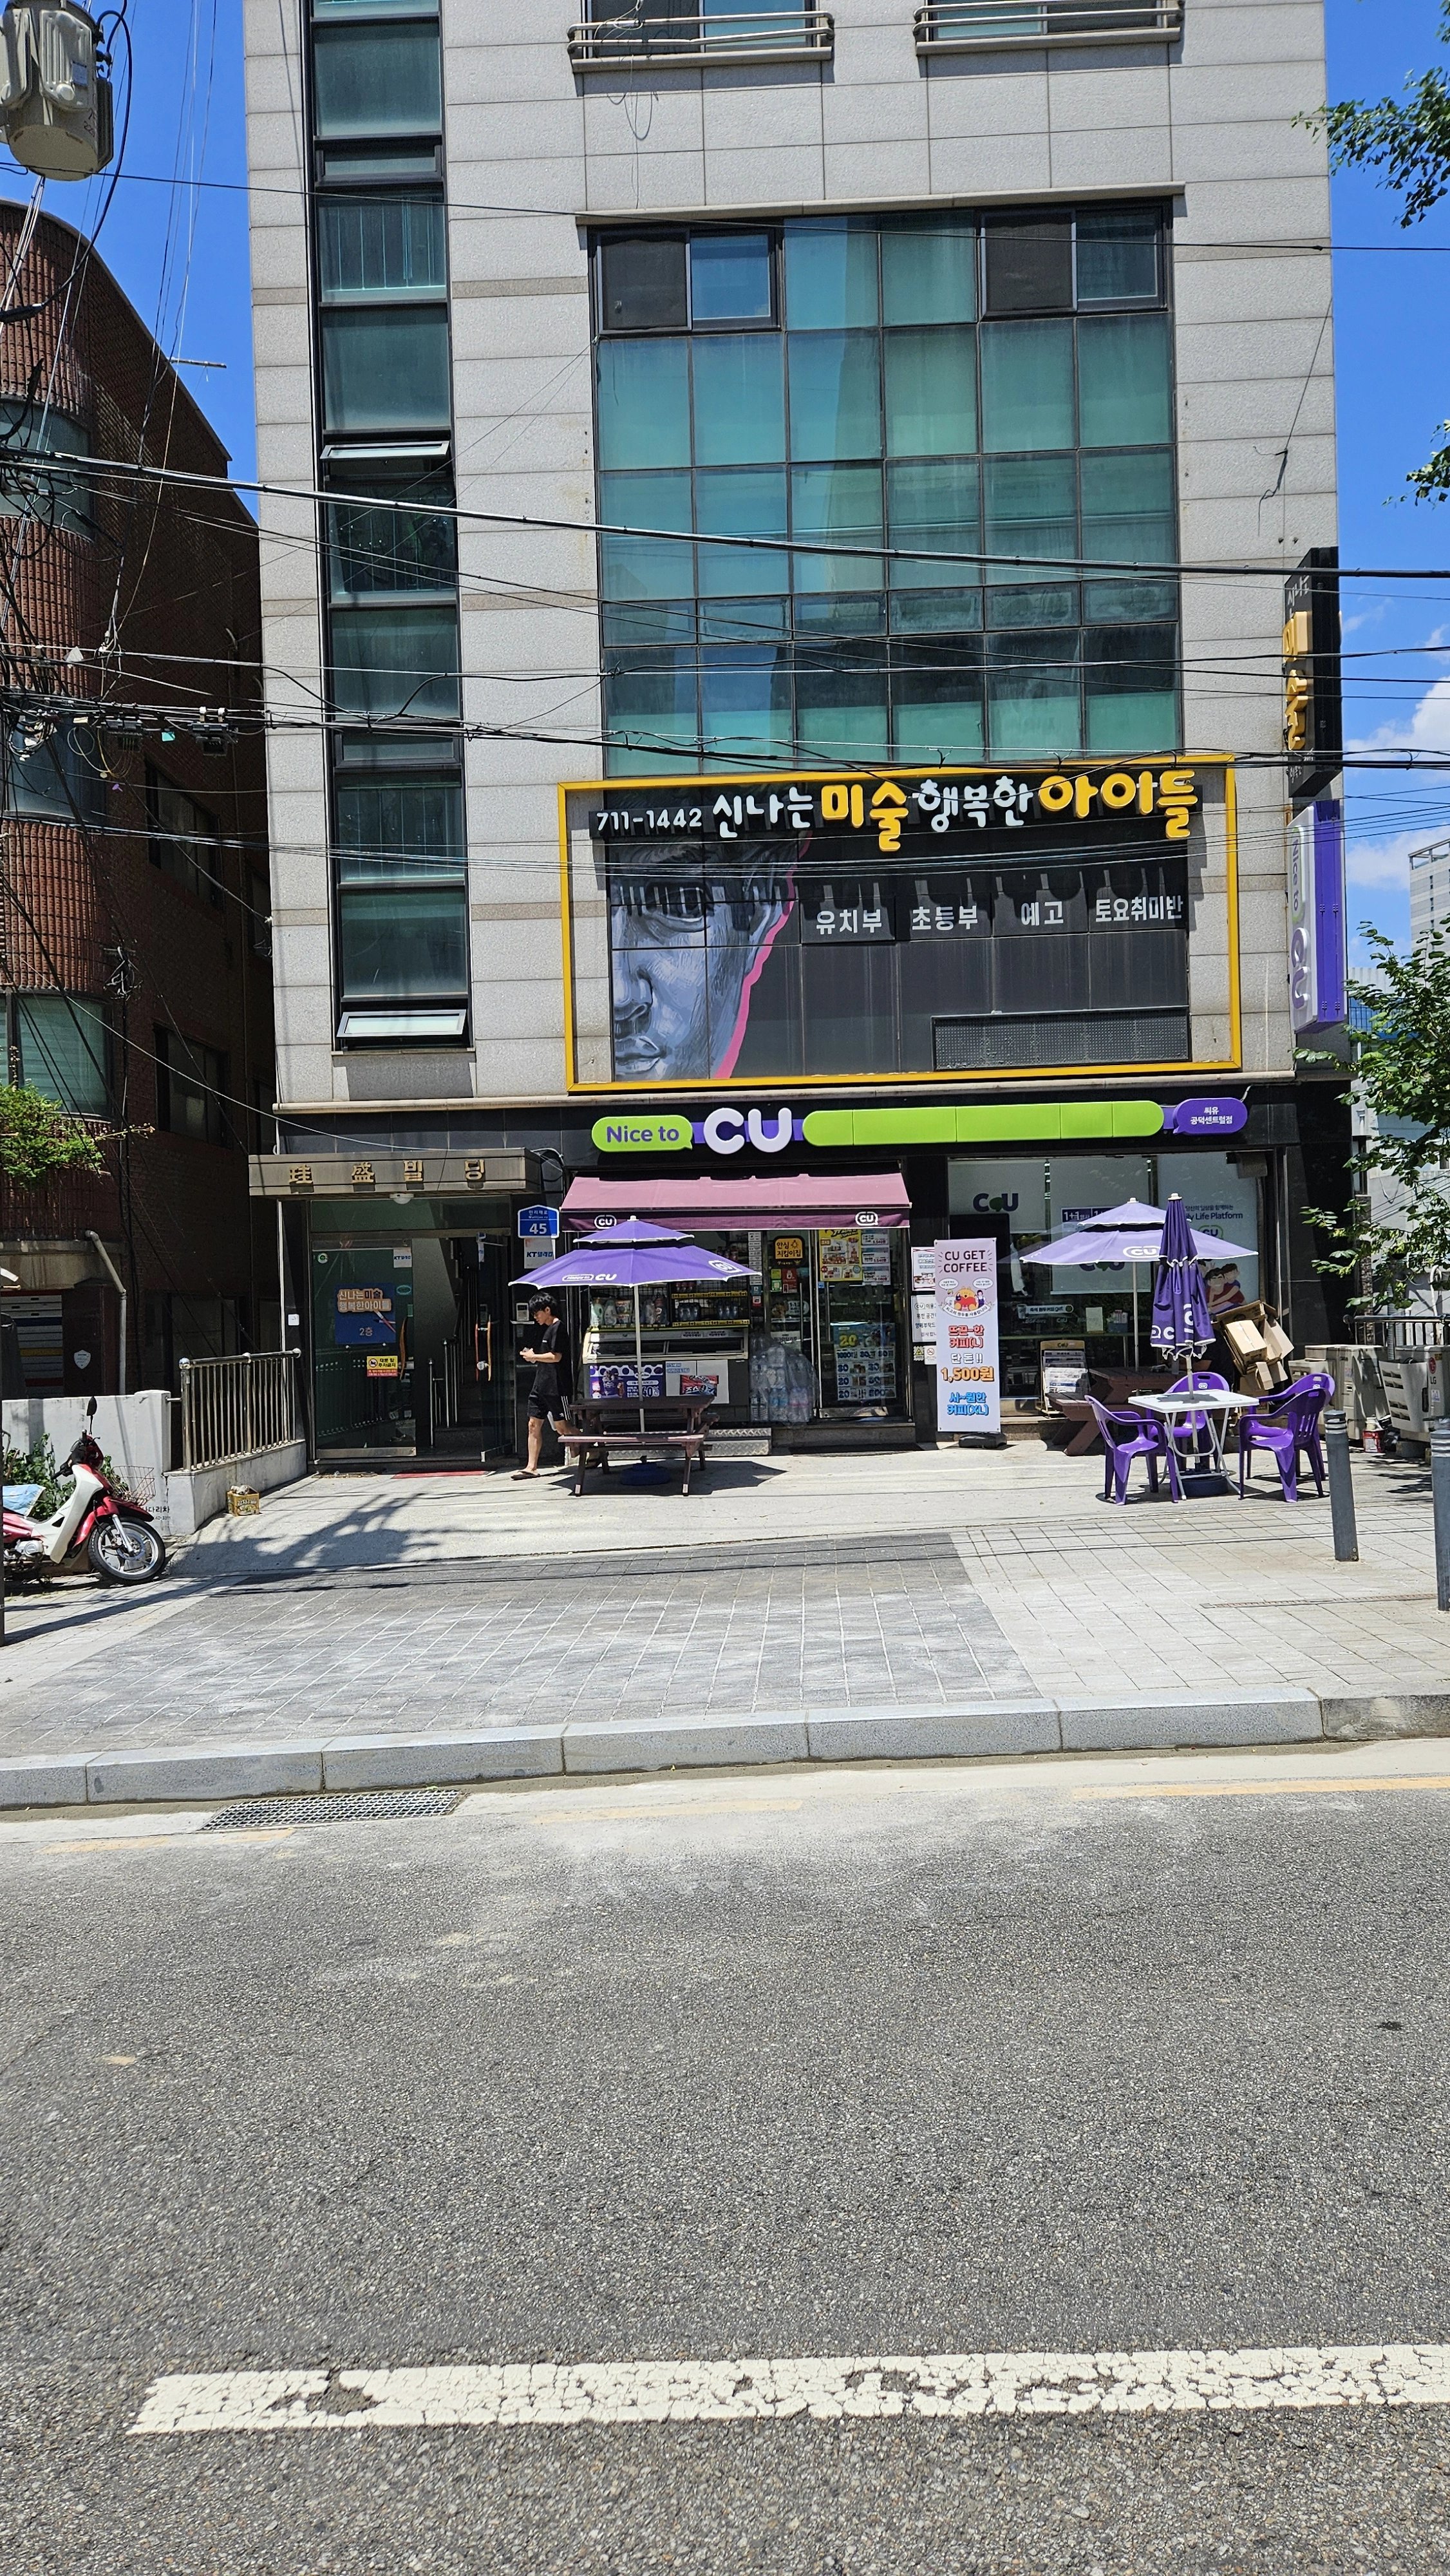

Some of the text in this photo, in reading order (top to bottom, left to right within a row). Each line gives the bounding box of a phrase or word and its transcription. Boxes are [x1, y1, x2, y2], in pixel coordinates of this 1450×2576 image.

[596, 769, 1198, 852] 711-1442 신나는 미술 행복한 아이들
[1293, 890, 1299, 911] to
[1021, 901, 1064, 927] 예고
[1095, 895, 1183, 922] 토요취미반
[816, 909, 882, 934] 유치부
[912, 905, 978, 931] 초등부
[1292, 927, 1308, 1009] CU
[1204, 1106, 1219, 1115] 씨유
[1190, 1115, 1233, 1125] 공덕센트럴점
[607, 1107, 793, 1155] Nice to CU
[973, 1193, 1019, 1212] CU
[859, 1215, 874, 1223] CU
[1196, 1212, 1210, 1220] Life
[1210, 1211, 1244, 1220] Platform
[529, 1223, 547, 1235] 45
[777, 1249, 802, 1258] 지킴이집
[945, 1250, 986, 1260] CU GET
[1131, 1247, 1157, 1256] CU
[943, 1262, 988, 1273] COFFEE
[359, 1327, 373, 1336] 2층
[949, 1337, 984, 1349] 커피(L)
[941, 1366, 995, 1383] 1,500원
[1430, 1376, 1437, 1385] LG
[947, 1404, 989, 1416] 커피(XL)
